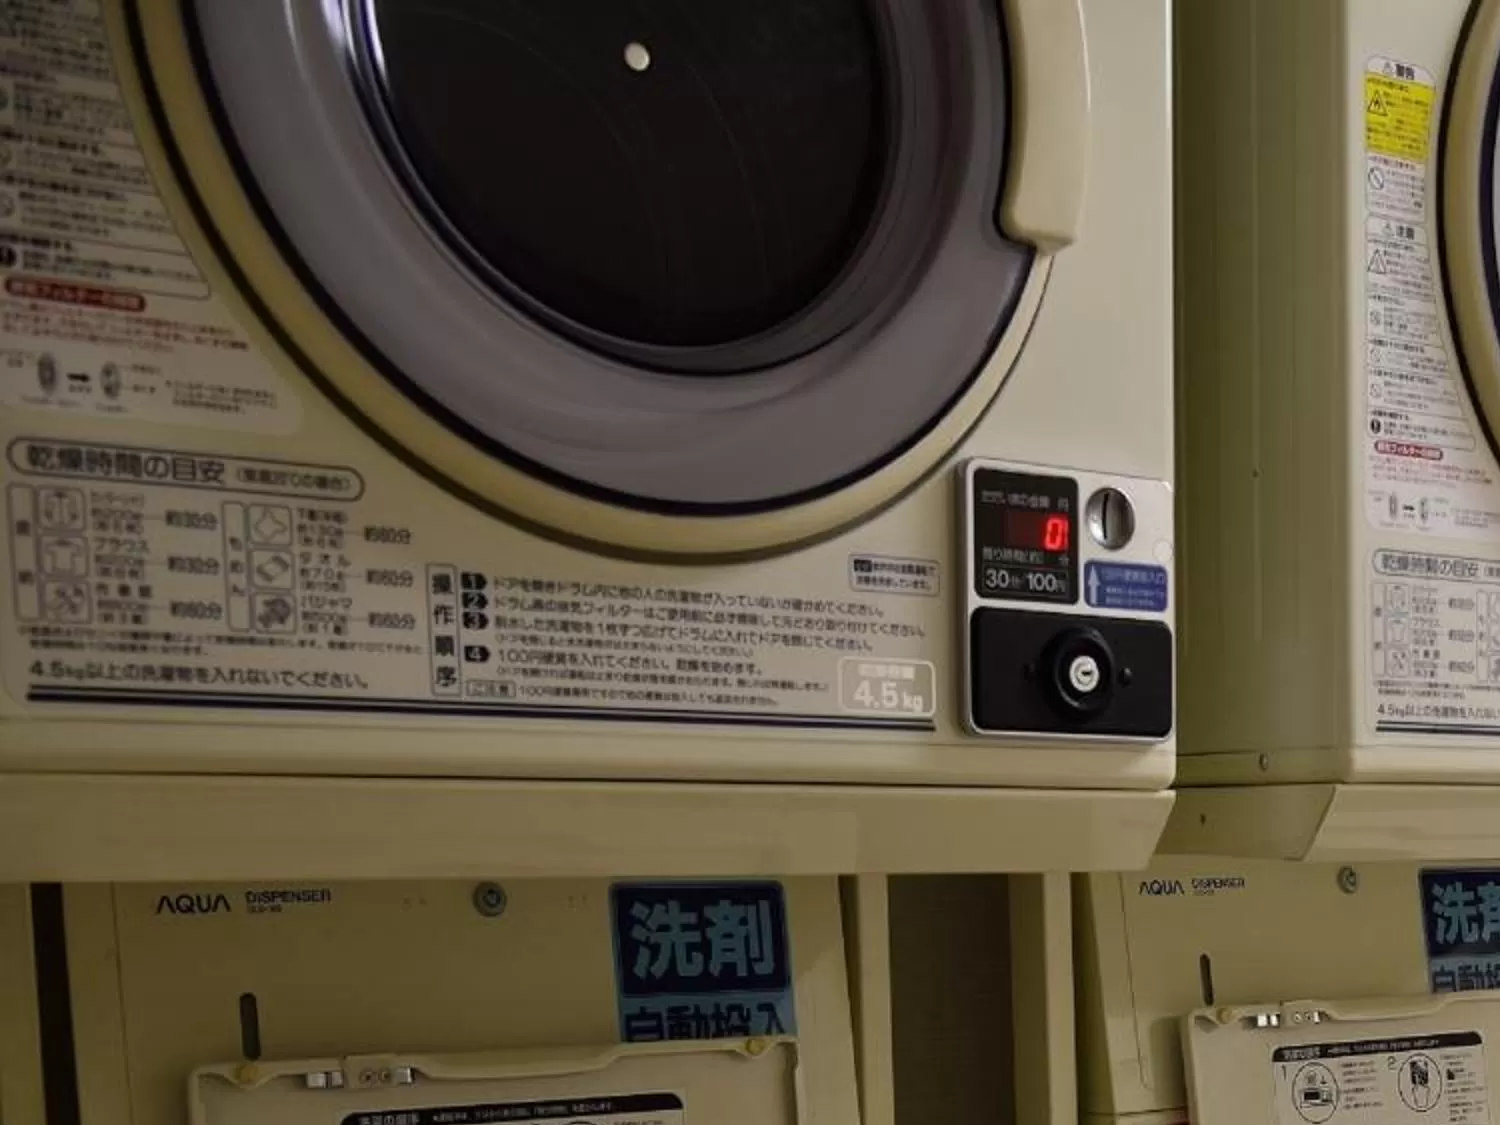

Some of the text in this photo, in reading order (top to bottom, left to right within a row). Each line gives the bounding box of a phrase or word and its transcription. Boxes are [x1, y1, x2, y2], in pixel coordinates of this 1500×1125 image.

[1045, 517, 1064, 551] 0
[156, 893, 232, 915] AQUA
[1138, 881, 1185, 896] AQUA
[631, 899, 776, 980] 洗剤
[624, 1001, 787, 1043] 自動投入
